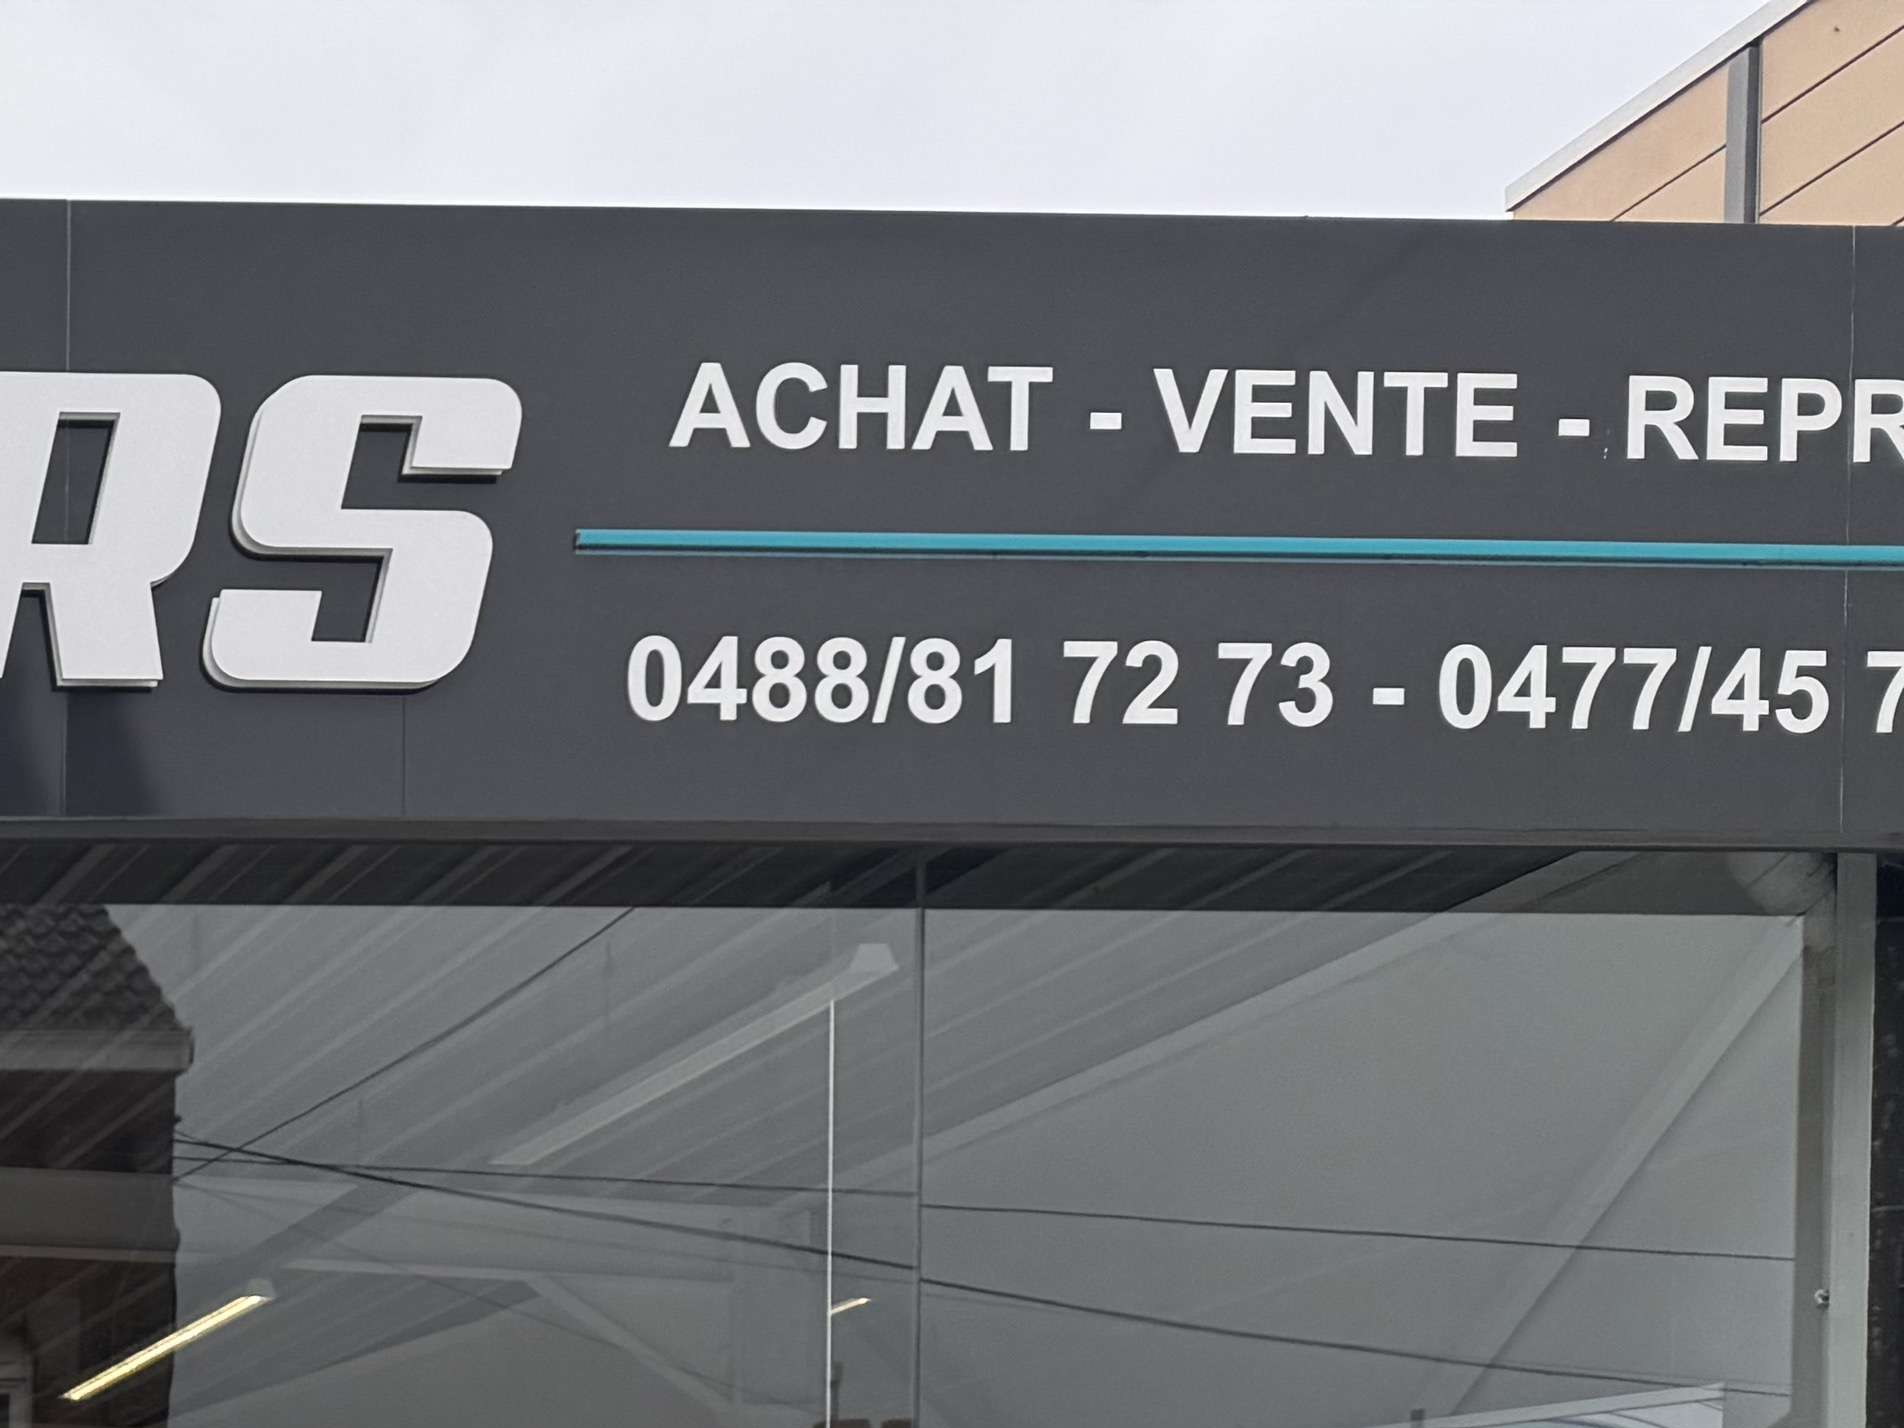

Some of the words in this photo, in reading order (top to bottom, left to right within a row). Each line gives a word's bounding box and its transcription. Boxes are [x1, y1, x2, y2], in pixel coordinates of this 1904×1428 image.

[668, 361, 1053, 451] ACHAT
[1089, 410, 1122, 429] -
[1153, 367, 1520, 459] VENTE
[1556, 417, 1590, 437] -
[626, 635, 1016, 728] 0488/81
[1063, 639, 1179, 727] 72
[1217, 641, 1335, 729] 73
[1373, 686, 1405, 706] -
[1439, 643, 1830, 734] 0477/45
